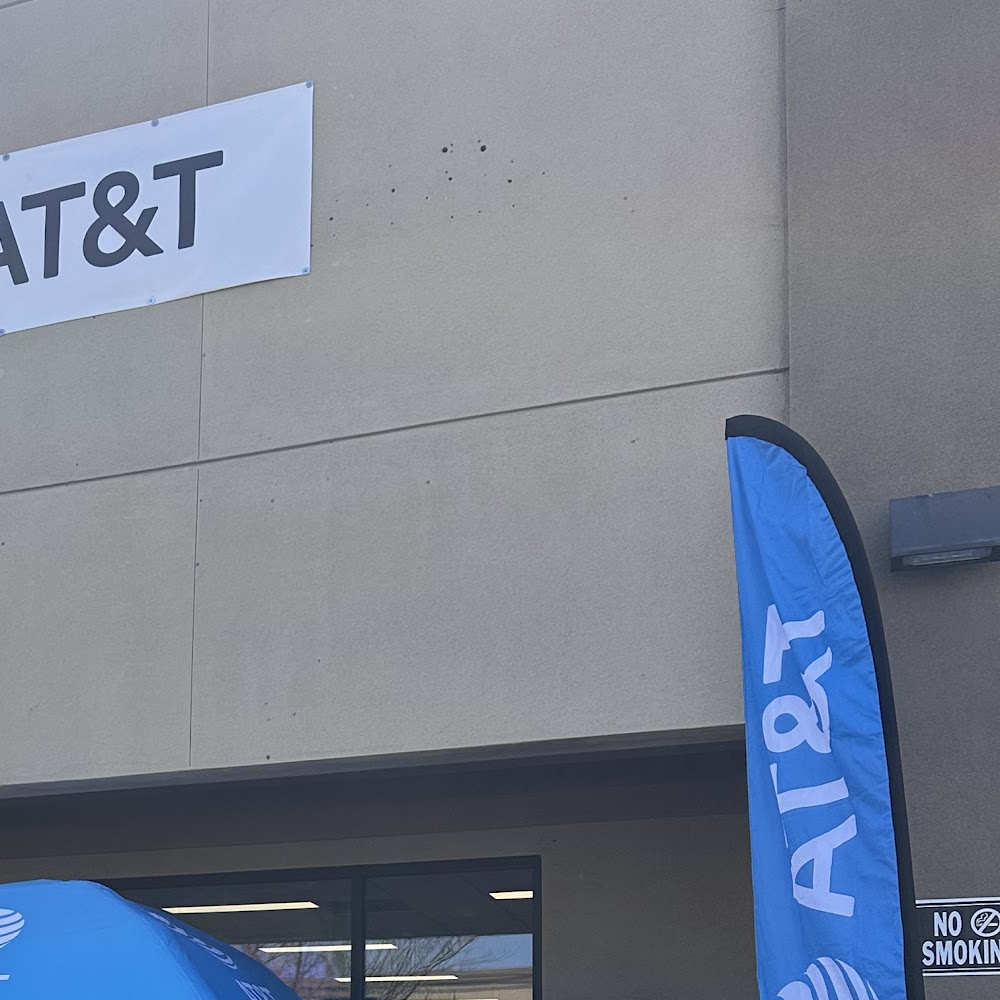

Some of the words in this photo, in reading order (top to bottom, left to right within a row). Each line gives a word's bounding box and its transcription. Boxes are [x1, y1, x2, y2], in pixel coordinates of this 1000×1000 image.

[762, 603, 857, 918] AT&T
[933, 911, 962, 937] NO
[922, 939, 1000, 966] SMOKIN
